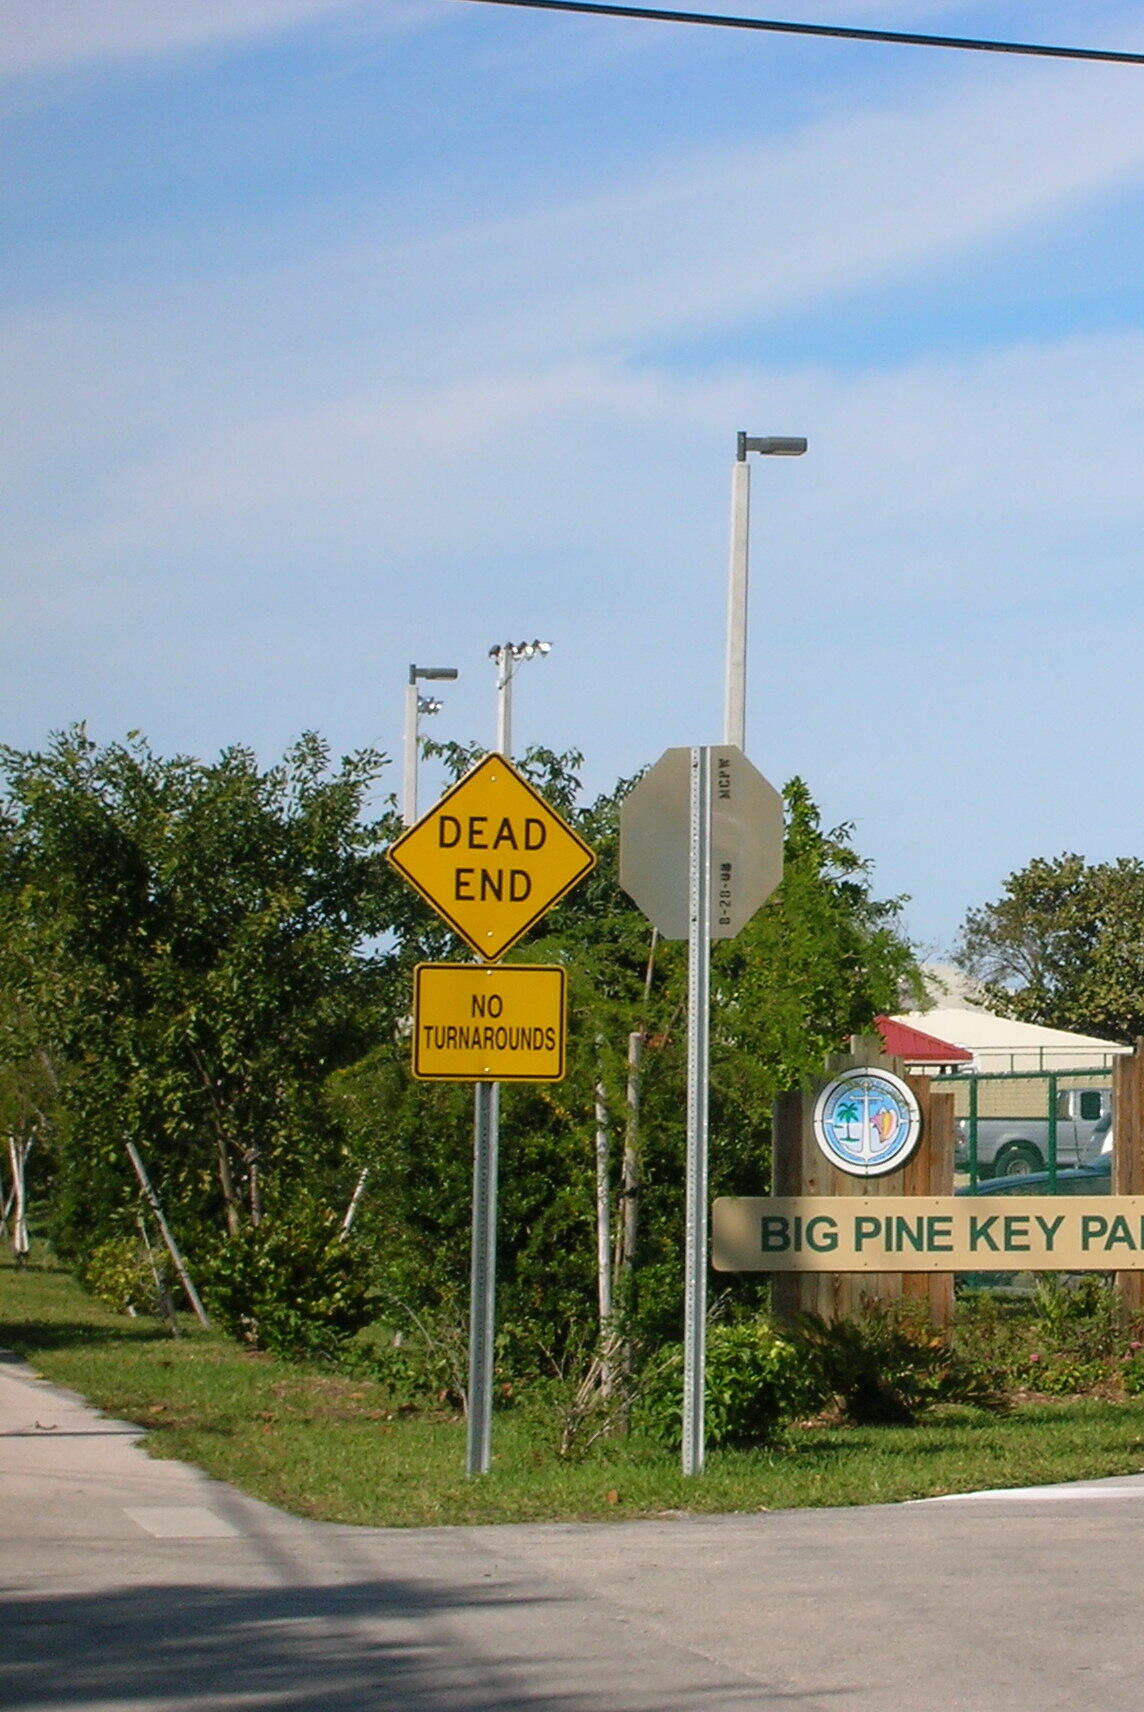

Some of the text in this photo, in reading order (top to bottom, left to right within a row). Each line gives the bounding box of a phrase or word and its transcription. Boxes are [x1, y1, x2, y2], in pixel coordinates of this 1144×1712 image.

[718, 758, 730, 800] MCPW
[438, 815, 547, 851] DEAD
[455, 867, 532, 902] END
[471, 994, 503, 1018] NO
[424, 1025, 556, 1051] TURNAROUNDS
[760, 1215, 839, 1254] BIG
[854, 1215, 954, 1253] PINE
[969, 1214, 1066, 1252] KEY
